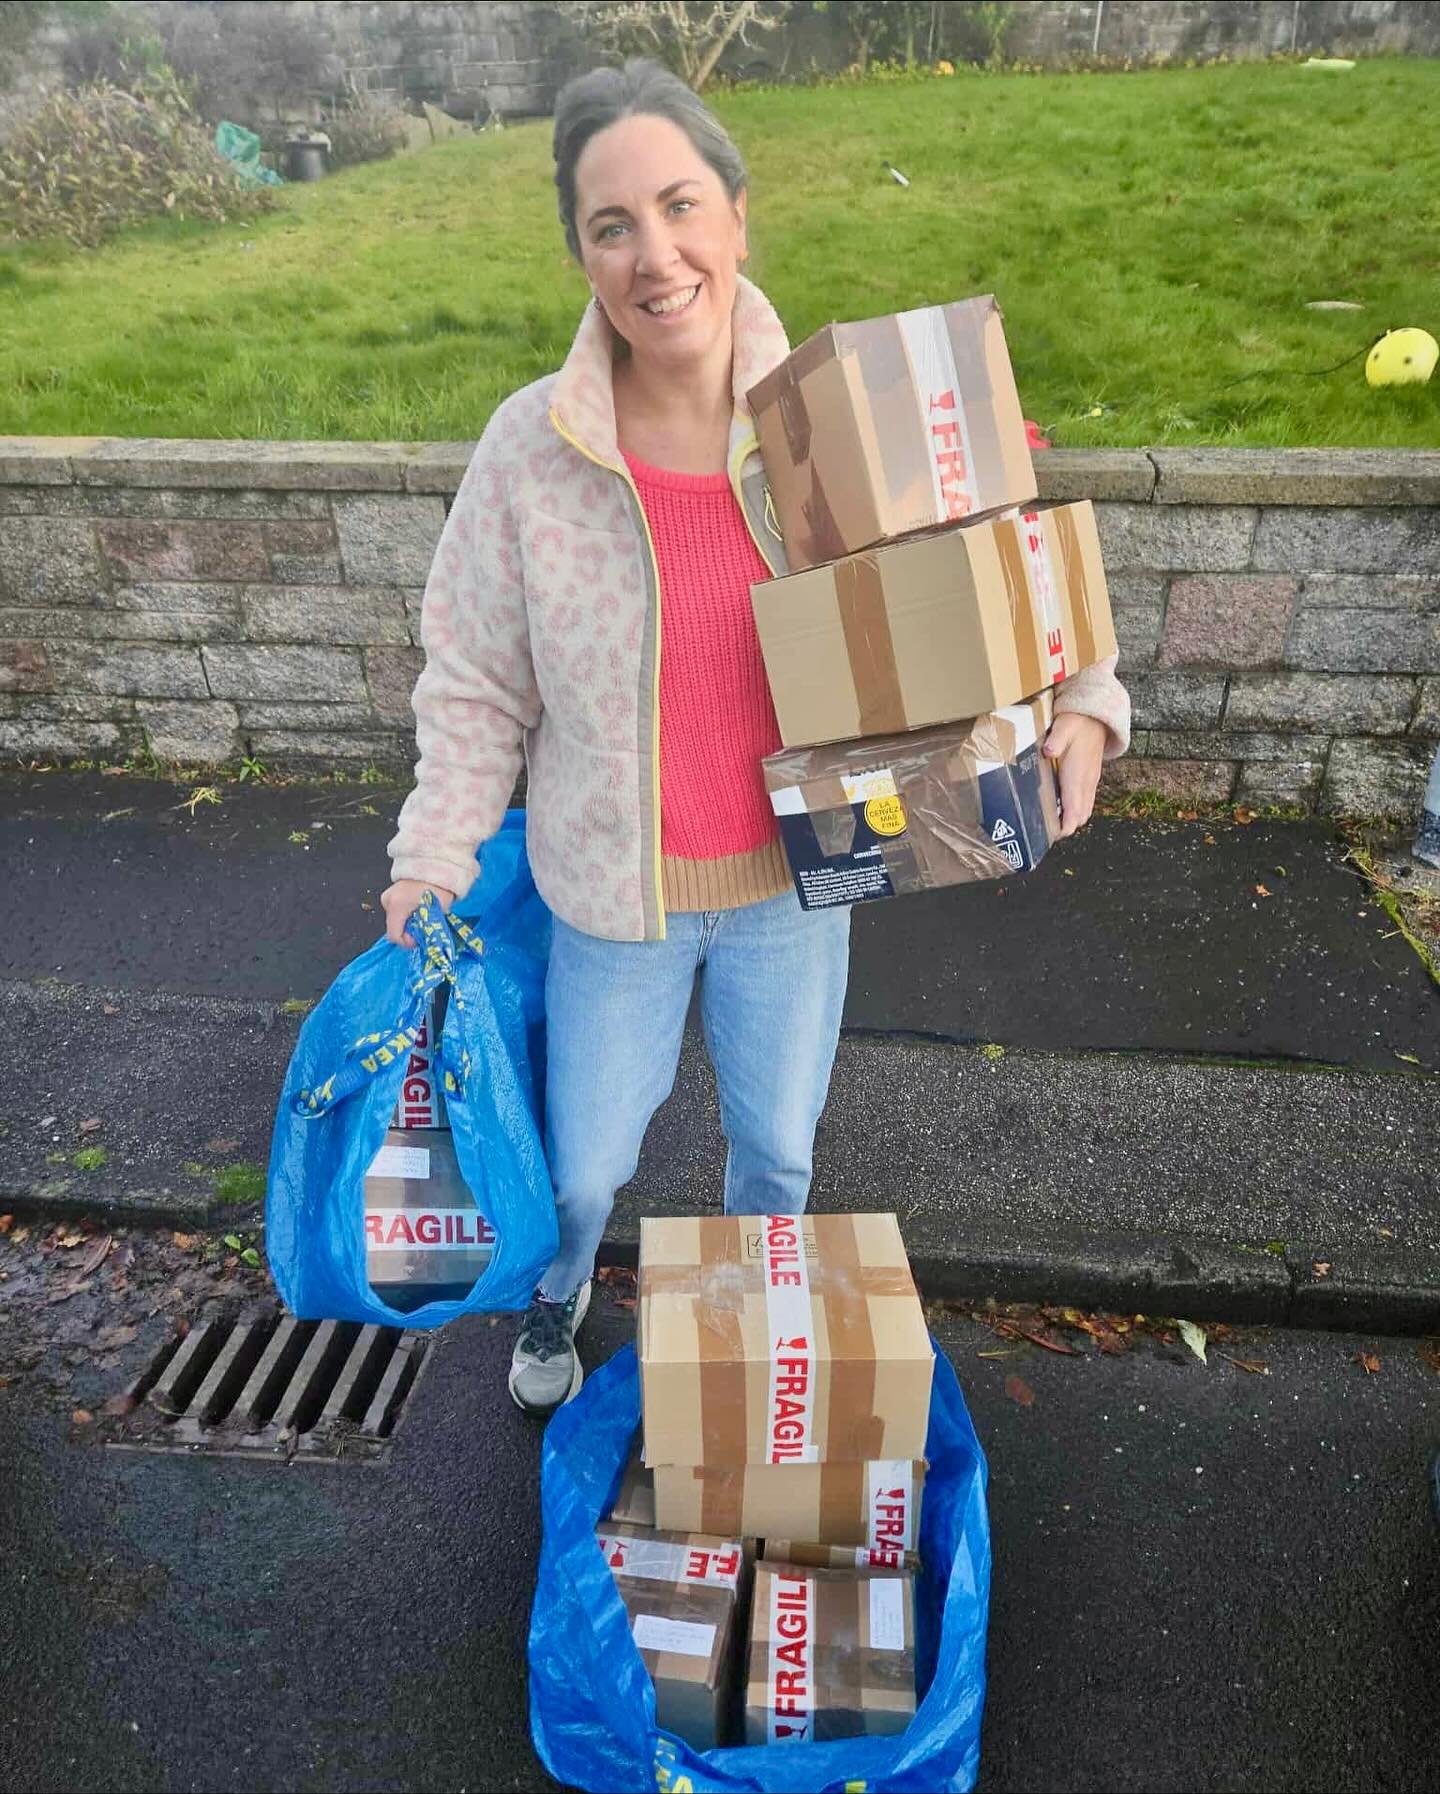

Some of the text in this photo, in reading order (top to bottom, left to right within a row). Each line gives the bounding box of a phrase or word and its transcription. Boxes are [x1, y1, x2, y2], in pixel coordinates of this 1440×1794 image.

[869, 804, 903, 817] CERVEZ
[360, 1026, 418, 1073] IKEA
[767, 1215, 801, 1288] AGILE
[772, 1358, 808, 1464] FRAGIL
